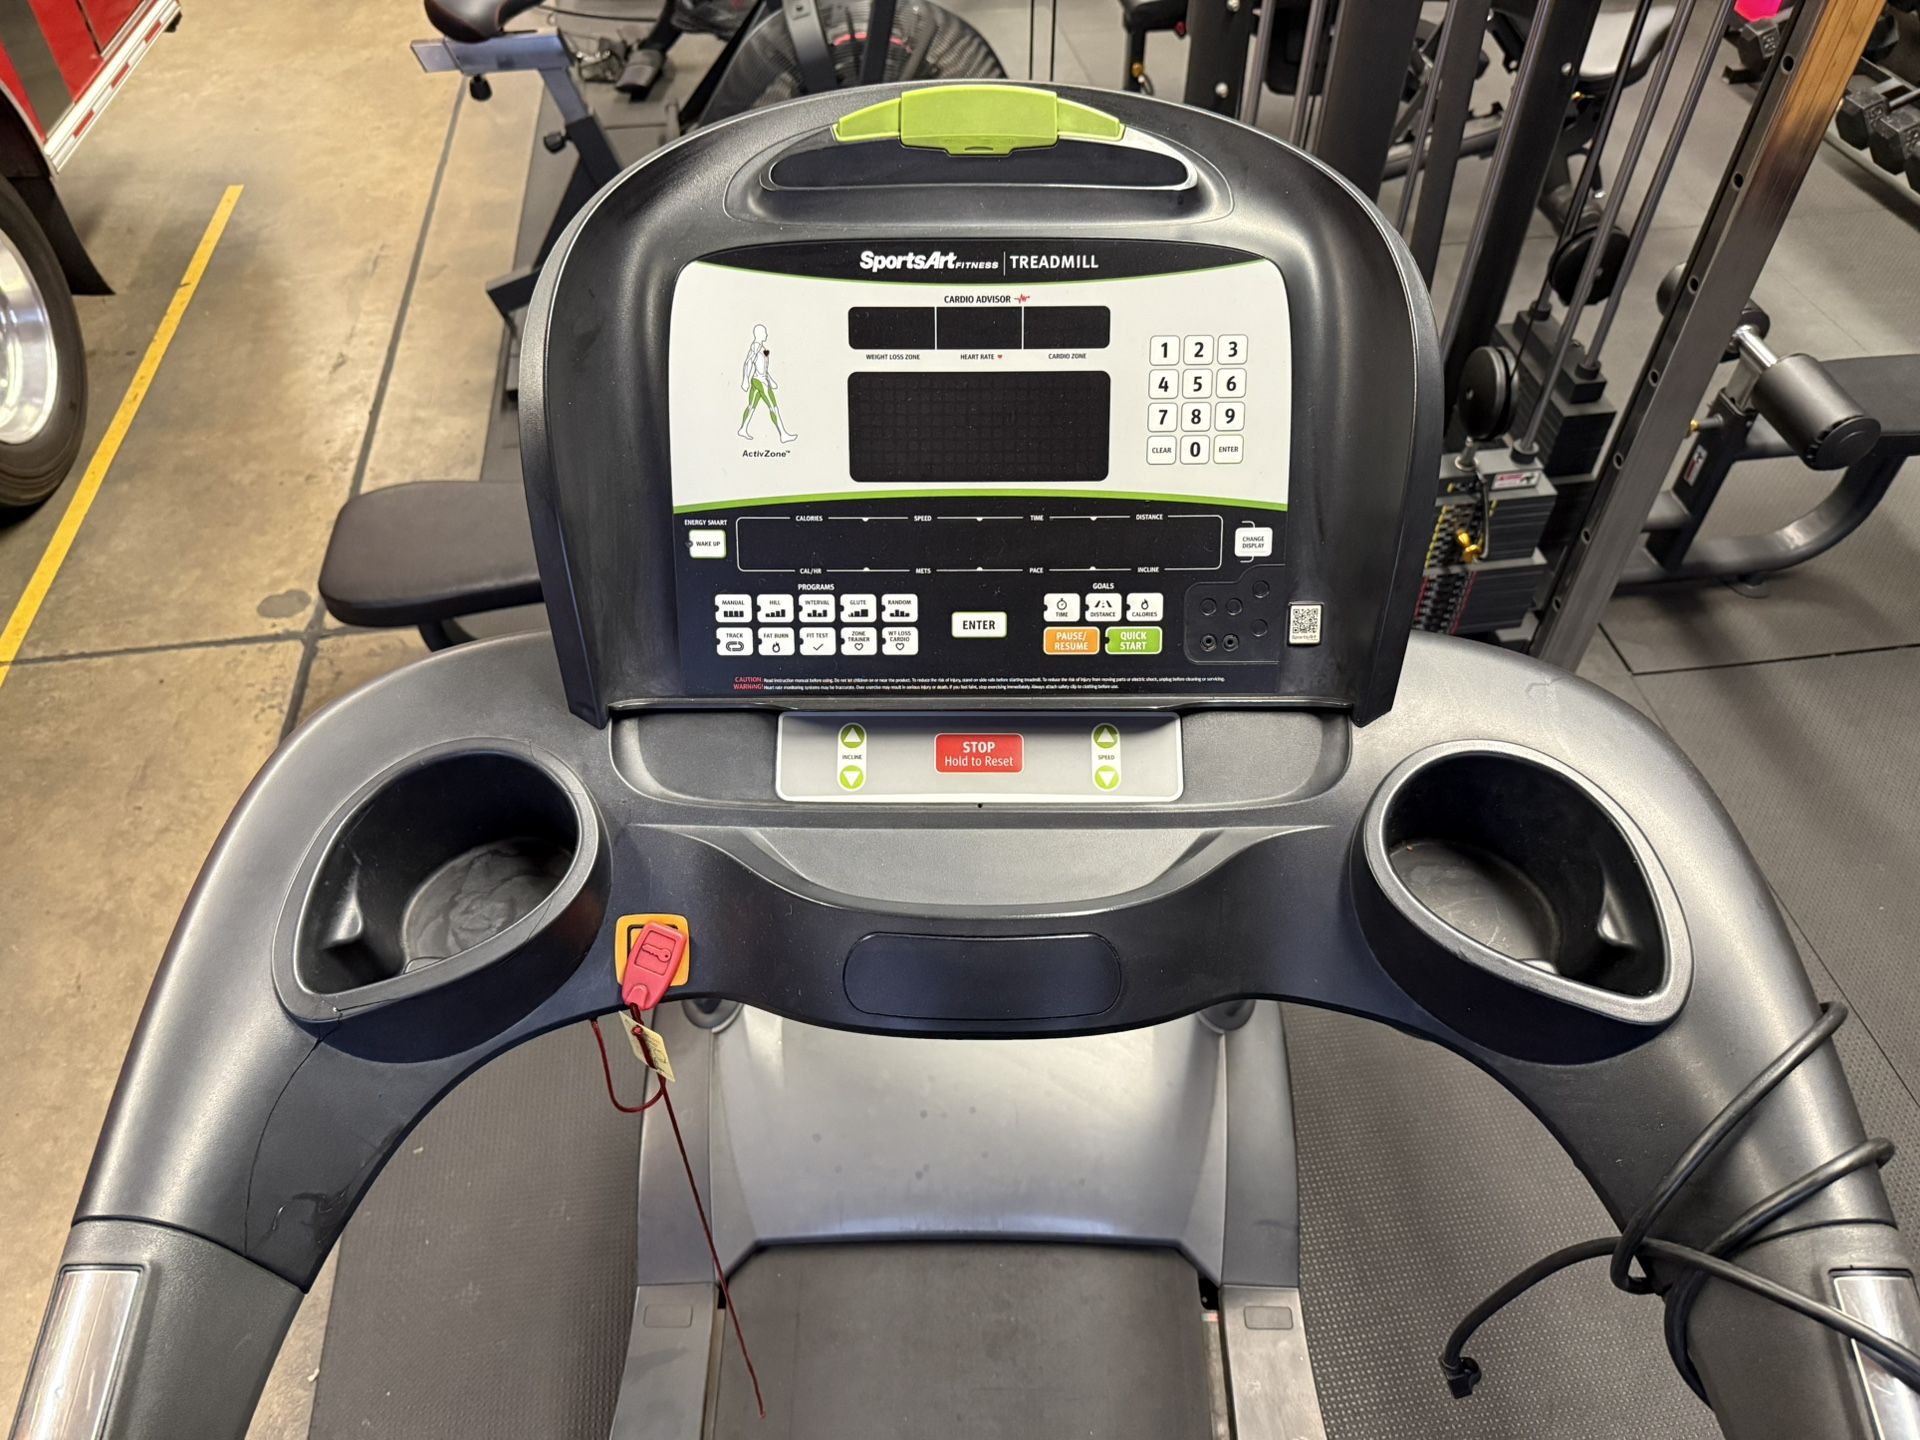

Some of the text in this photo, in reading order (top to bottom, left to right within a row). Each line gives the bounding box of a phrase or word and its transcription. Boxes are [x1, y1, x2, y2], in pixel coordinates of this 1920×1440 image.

[860, 251, 957, 272] SportsArt
[1010, 255, 1098, 268] TREADMILL
[1161, 343, 1167, 358] 1
[1194, 342, 1203, 357] 2
[1229, 342, 1237, 357] 3
[1158, 377, 1168, 392] 4
[1194, 376, 1202, 392] 5
[1227, 376, 1236, 391] 6
[1159, 410, 1167, 424] 7
[1191, 409, 1201, 424] 8
[1225, 409, 1235, 423] 9
[1190, 442, 1200, 457] 0
[963, 620, 995, 629] ENTER
[1056, 632, 1086, 640] PAUSE/
[1120, 632, 1146, 640] QUICK
[1055, 642, 1088, 650] RESUME
[1120, 639, 1147, 650] START
[963, 742, 995, 753] STOP
[945, 756, 1014, 767] Hold to Reset
